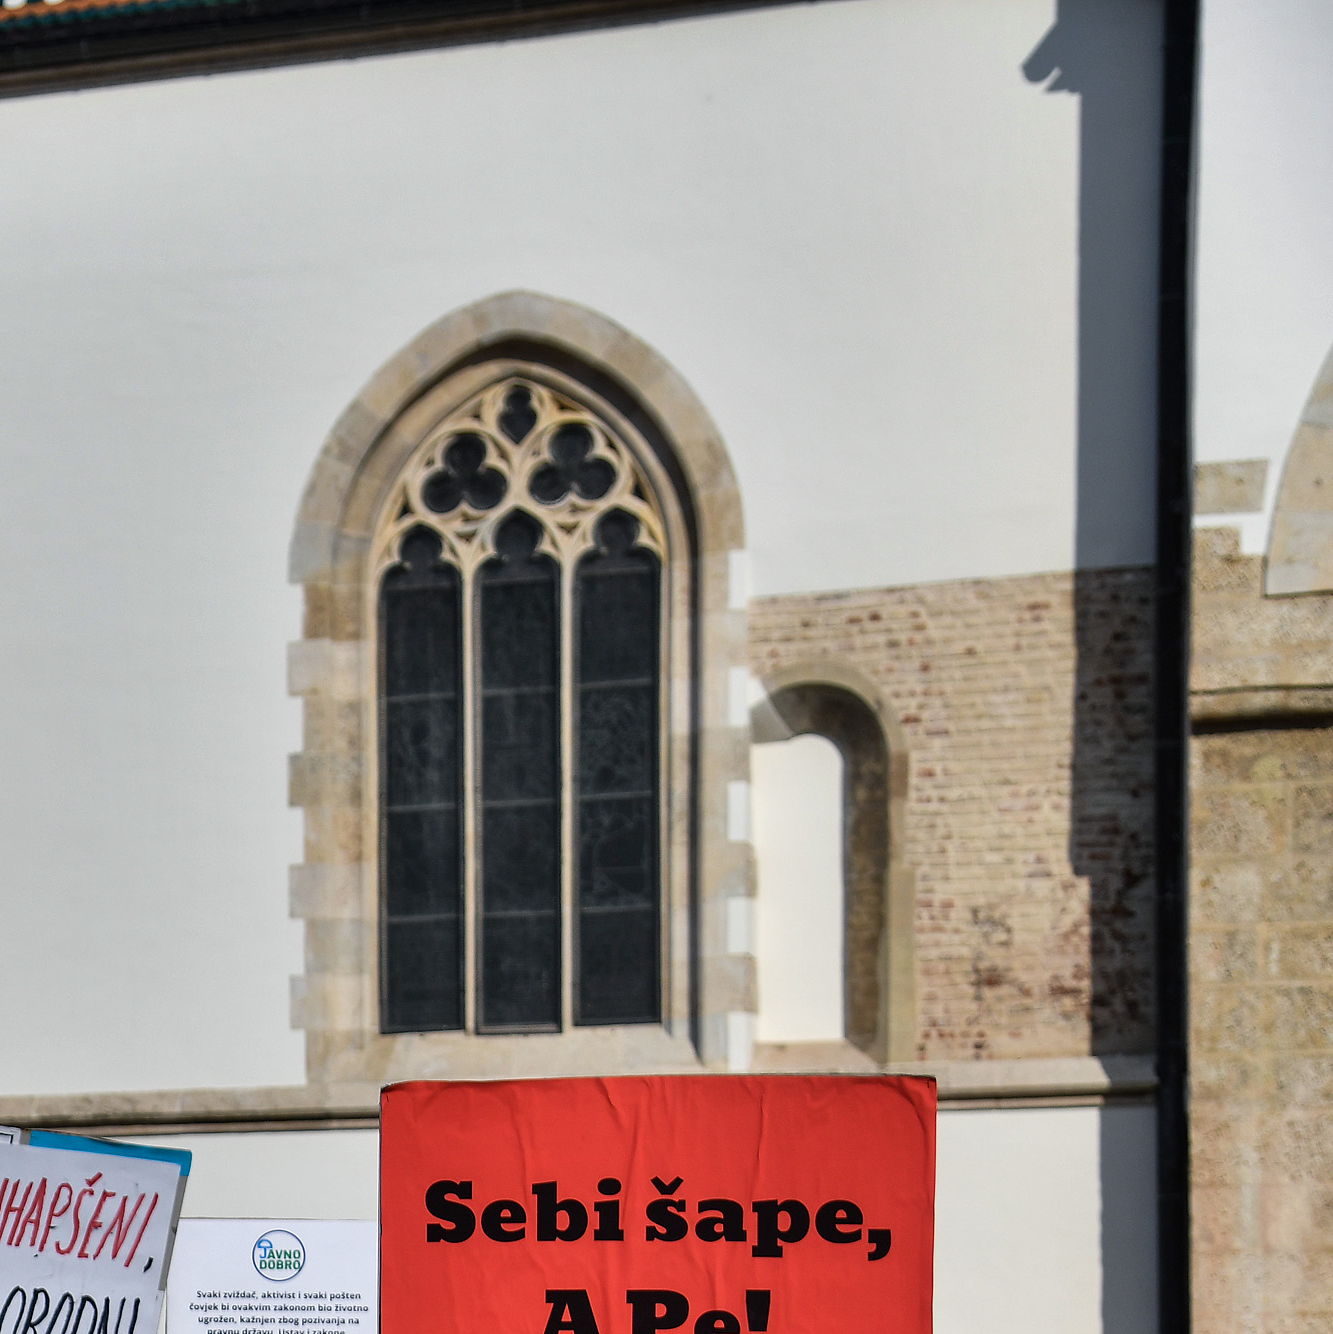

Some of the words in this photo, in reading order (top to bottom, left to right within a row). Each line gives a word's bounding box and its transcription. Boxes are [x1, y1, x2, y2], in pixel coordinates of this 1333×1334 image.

[425, 1177, 625, 1244] Sebi
[645, 1176, 892, 1262] šape,
[258, 1243, 301, 1260] JAVNO
[259, 1260, 301, 1270] DOBRO
[197, 1290, 221, 1298] Svaki
[223, 1291, 258, 1300] zviždač,
[261, 1291, 296, 1299] aktivist
[298, 1291, 301, 1299] i
[303, 1291, 327, 1299] svaki
[330, 1292, 361, 1301] pošten
[189, 1303, 219, 1312] čovjek
[221, 1303, 229, 1311] bi
[232, 1303, 271, 1311] ovakvim
[273, 1303, 315, 1311] zakonom
[334, 1304, 369, 1312] životno
[198, 1315, 237, 1325] ugrožen,
[240, 1315, 276, 1325] kažnjen
[278, 1316, 299, 1326] zbog
[302, 1318, 346, 1326] pozivanja
